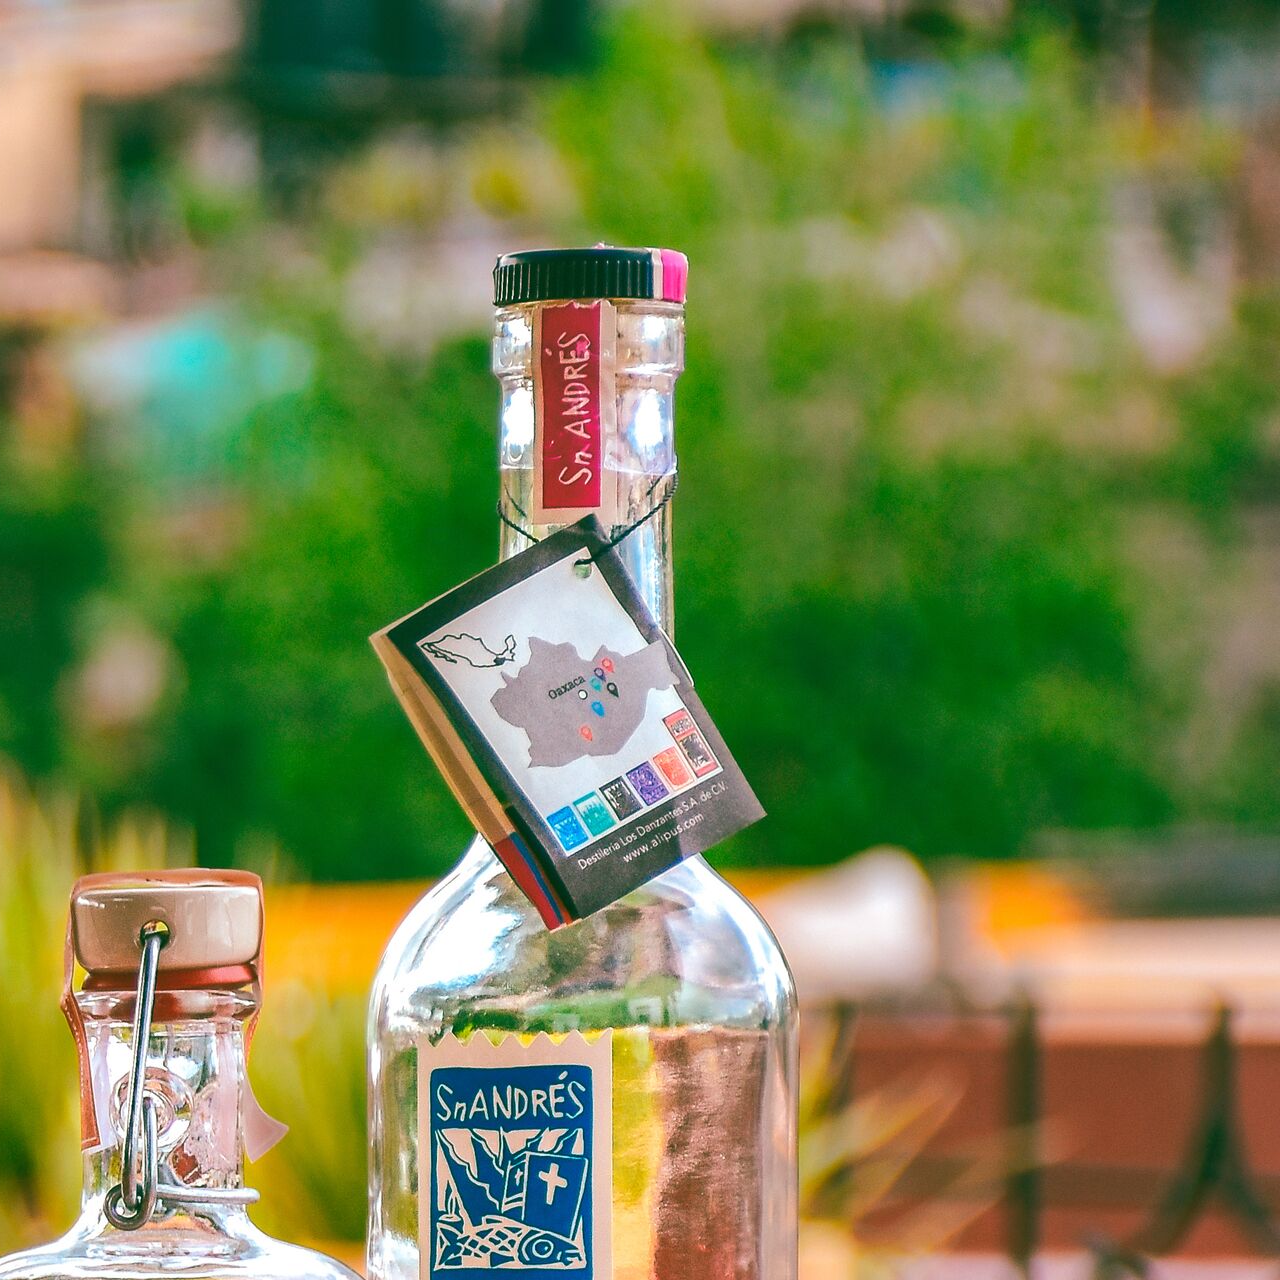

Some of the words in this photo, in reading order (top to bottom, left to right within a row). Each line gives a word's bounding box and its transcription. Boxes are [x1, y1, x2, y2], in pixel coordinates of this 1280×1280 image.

[548, 676, 586, 700] Oaxaca
[619, 831, 637, 847] Los
[638, 808, 686, 836] Danzantes
[701, 789, 713, 801] de
[623, 811, 705, 864] www.alipus.com
